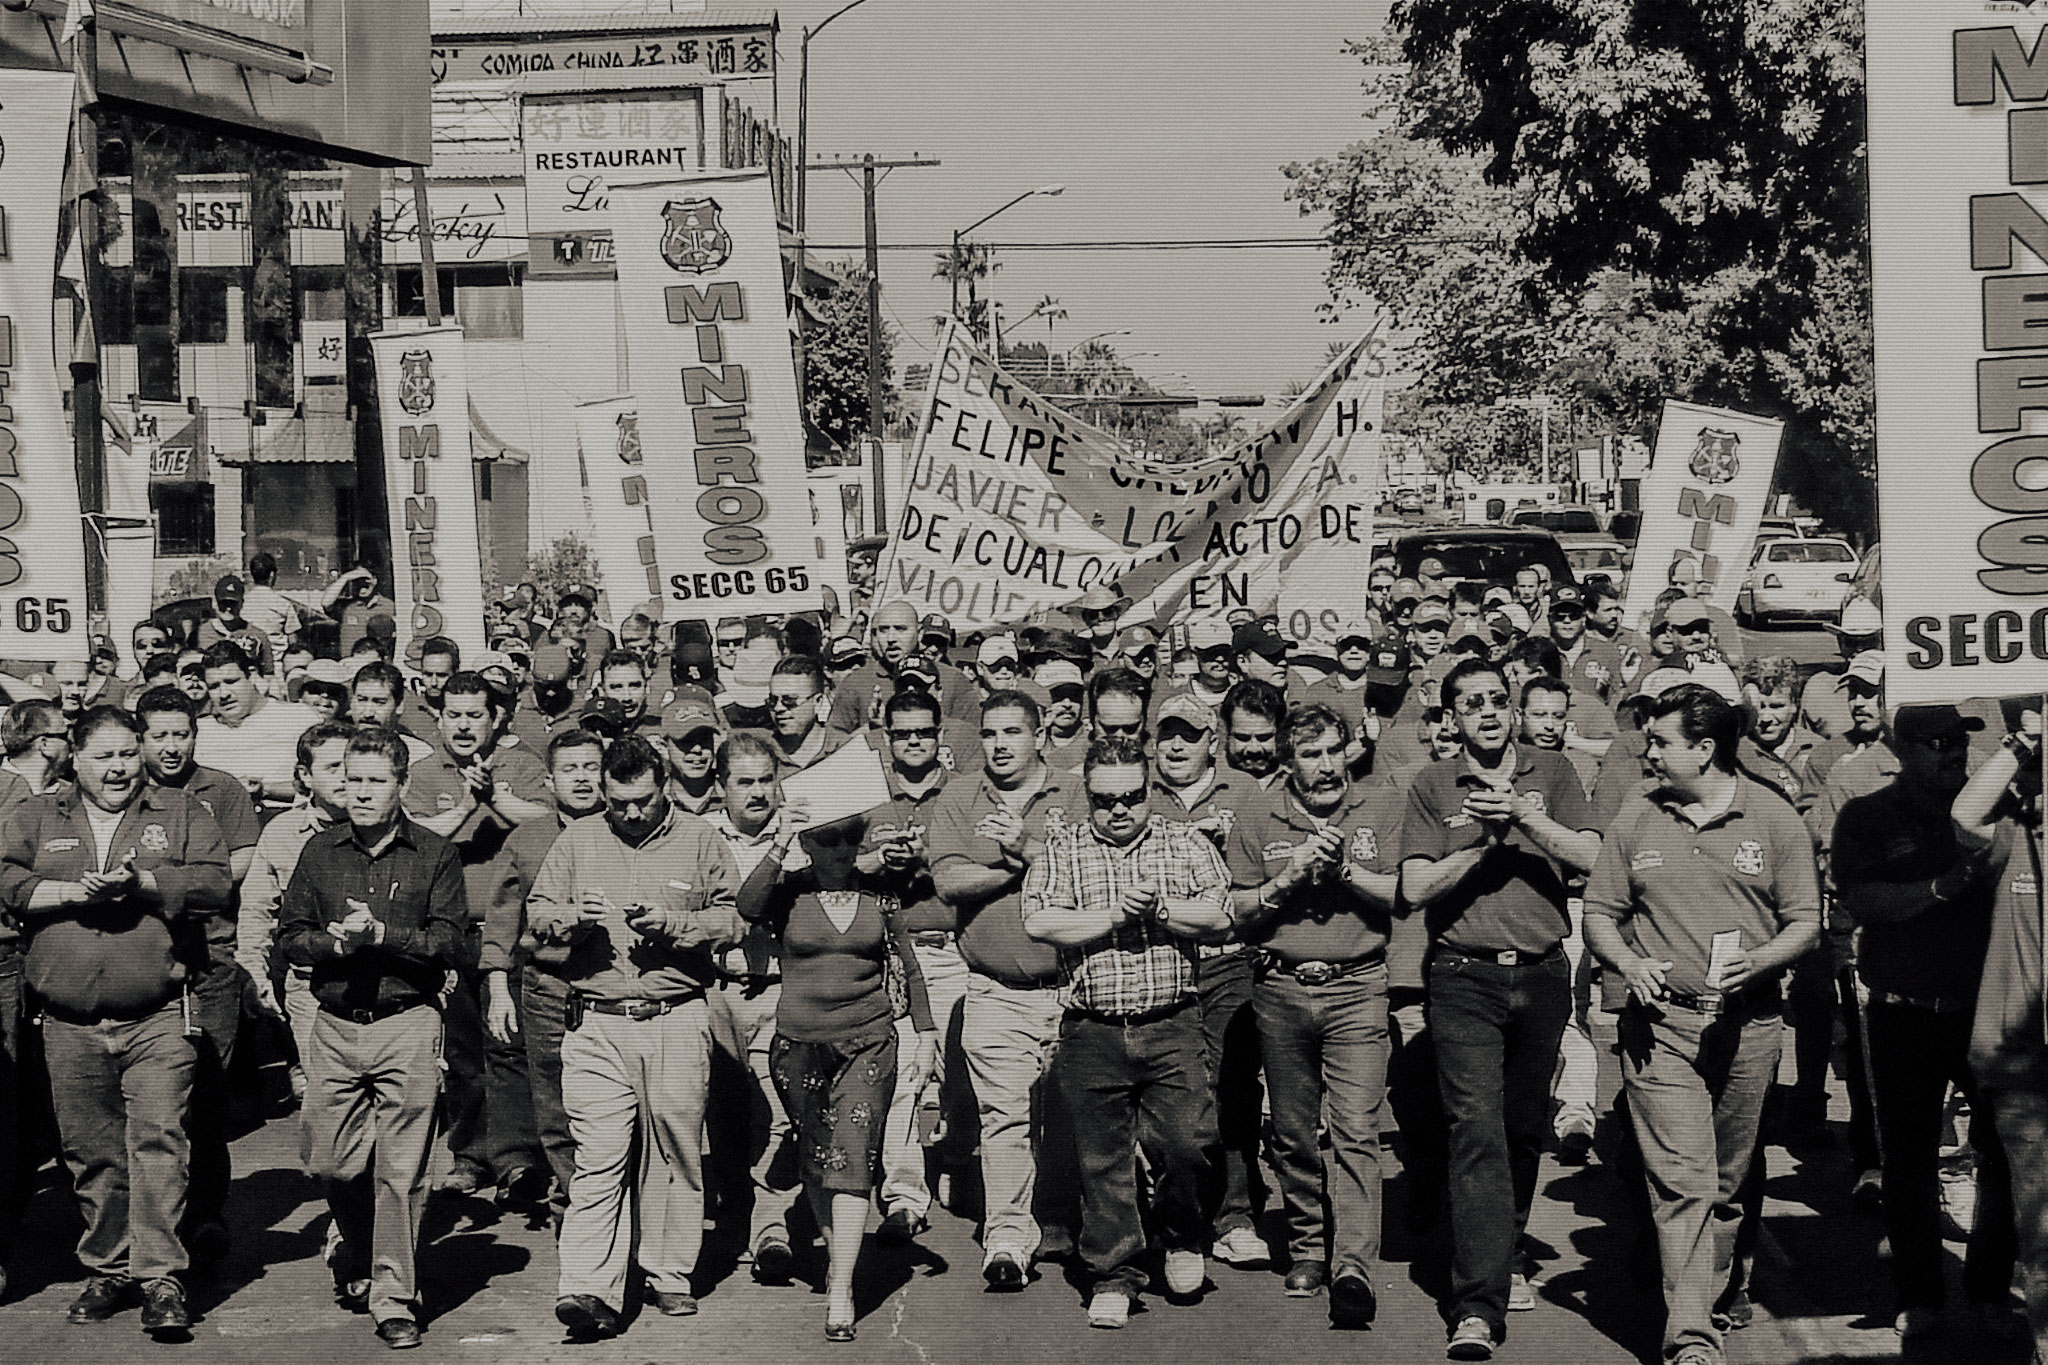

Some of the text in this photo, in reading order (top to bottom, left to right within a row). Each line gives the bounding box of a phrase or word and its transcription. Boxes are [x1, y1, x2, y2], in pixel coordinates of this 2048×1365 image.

[481, 51, 624, 75] COMIDA CHINA
[536, 147, 687, 171] RESTAURANT
[318, 336, 343, 361] 好
[664, 281, 768, 566] MINEROS
[928, 396, 1069, 476] FELIPE
[914, 455, 1068, 532] JAVIER
[902, 505, 949, 554] DE
[1202, 513, 1302, 563] ACTO
[1320, 504, 1362, 544] DE
[670, 565, 810, 601] SECC 65
[1190, 572, 1248, 609] EN
[15, 596, 71, 633] 65
